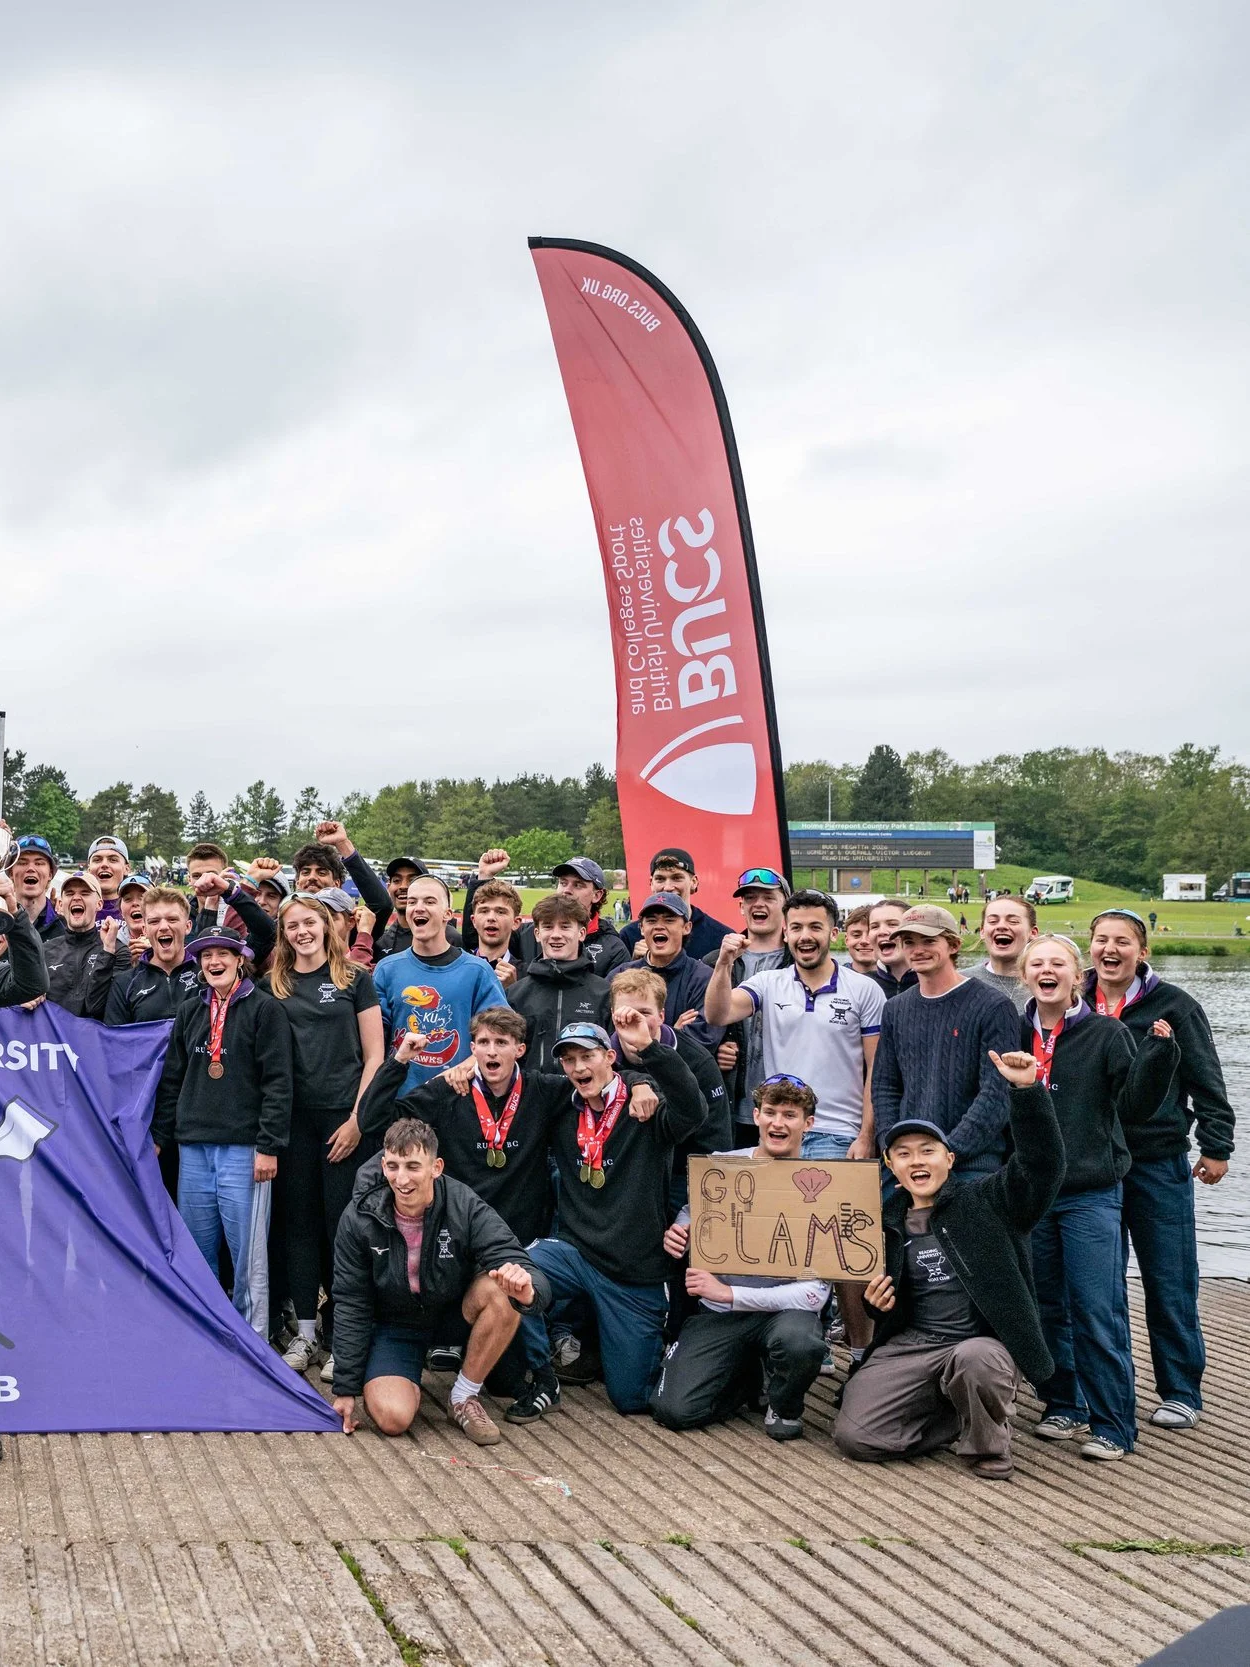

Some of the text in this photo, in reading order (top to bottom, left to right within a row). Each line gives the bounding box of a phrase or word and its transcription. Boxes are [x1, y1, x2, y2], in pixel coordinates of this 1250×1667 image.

[862, 823, 889, 831] Country
[1097, 1002, 1106, 1015] UCS
[423, 1012, 438, 1023] KU
[414, 1056, 443, 1064] AWKS
[509, 1093, 520, 1112] BUCS
[701, 1168, 755, 1203] GO
[695, 1209, 878, 1275] CLAMS
